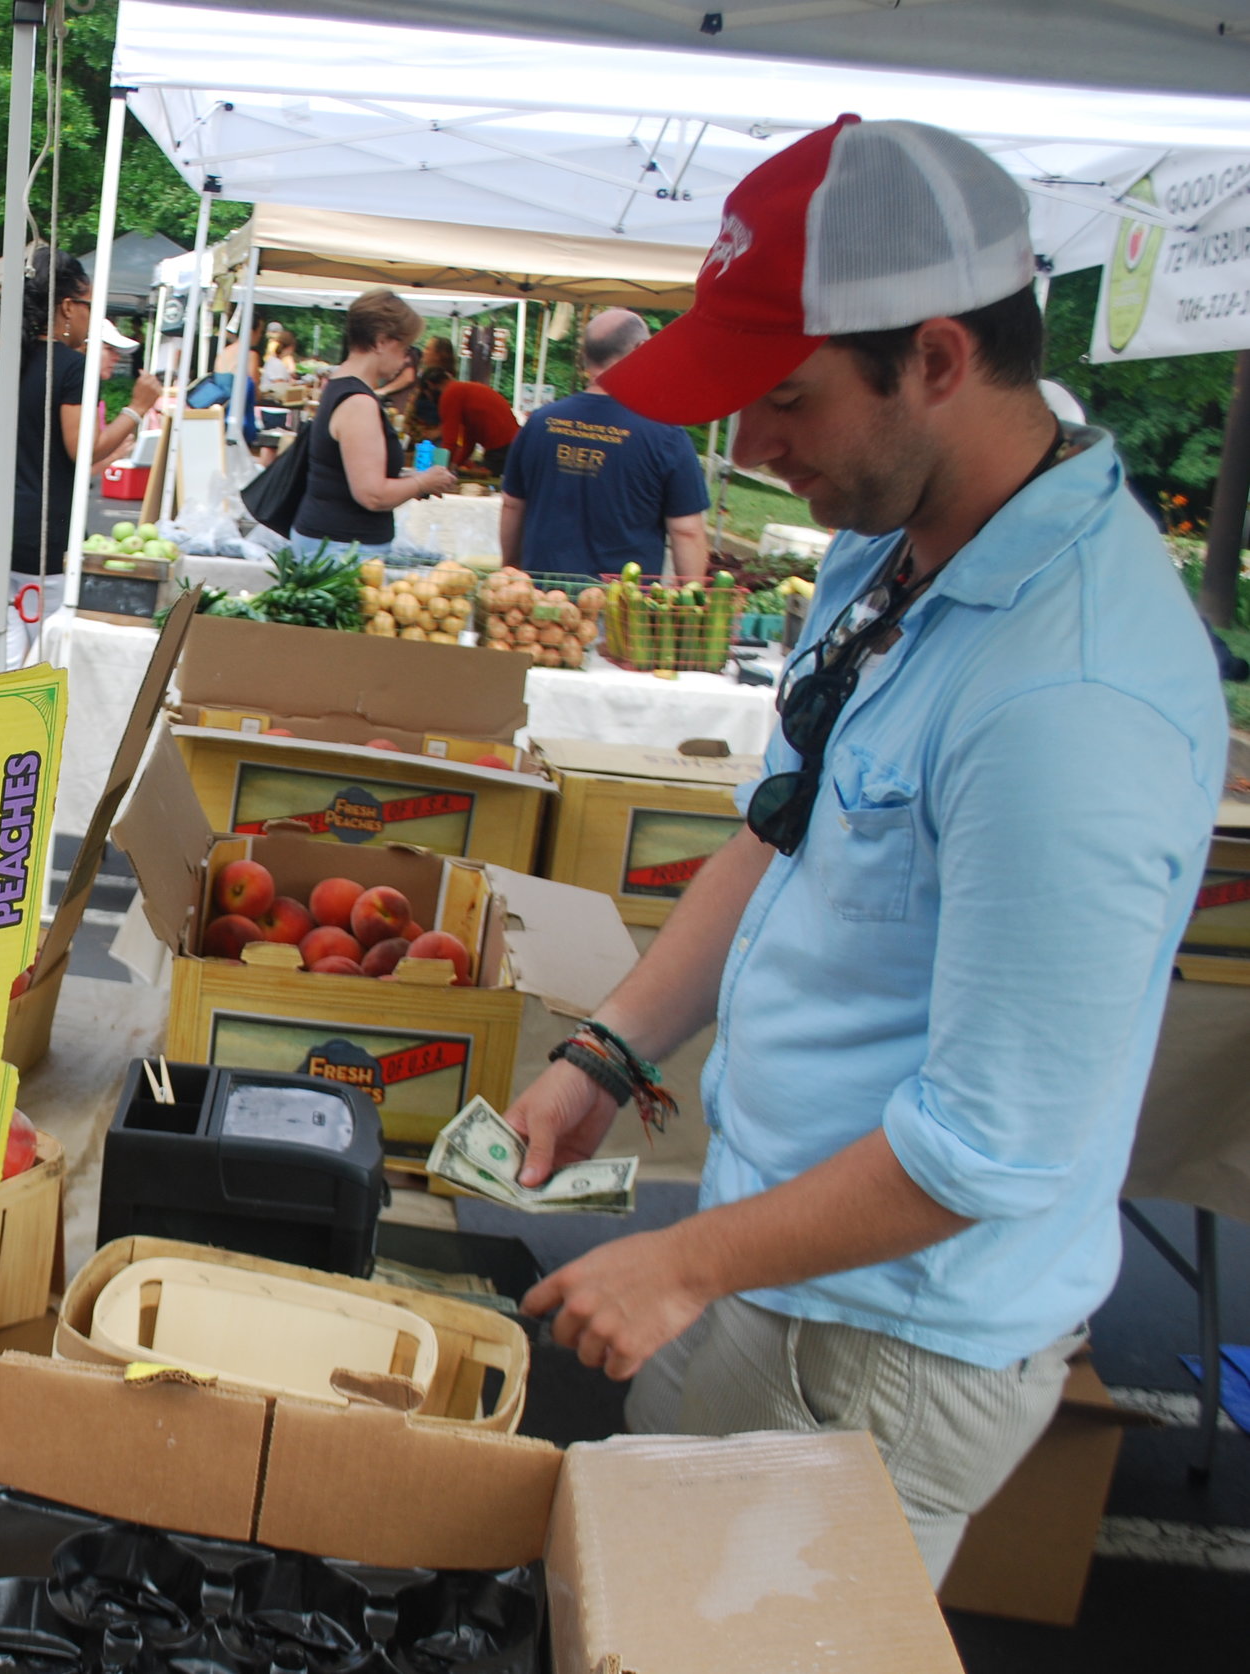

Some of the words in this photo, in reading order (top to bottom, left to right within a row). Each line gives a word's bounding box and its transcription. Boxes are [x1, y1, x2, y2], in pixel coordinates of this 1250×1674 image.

[1164, 172, 1216, 215] GOOD
[557, 443, 606, 467] BIER
[334, 798, 378, 819] FRESH
[324, 809, 384, 833] PEACHES
[308, 1055, 375, 1084] FRESH
[387, 1060, 404, 1079] OF
